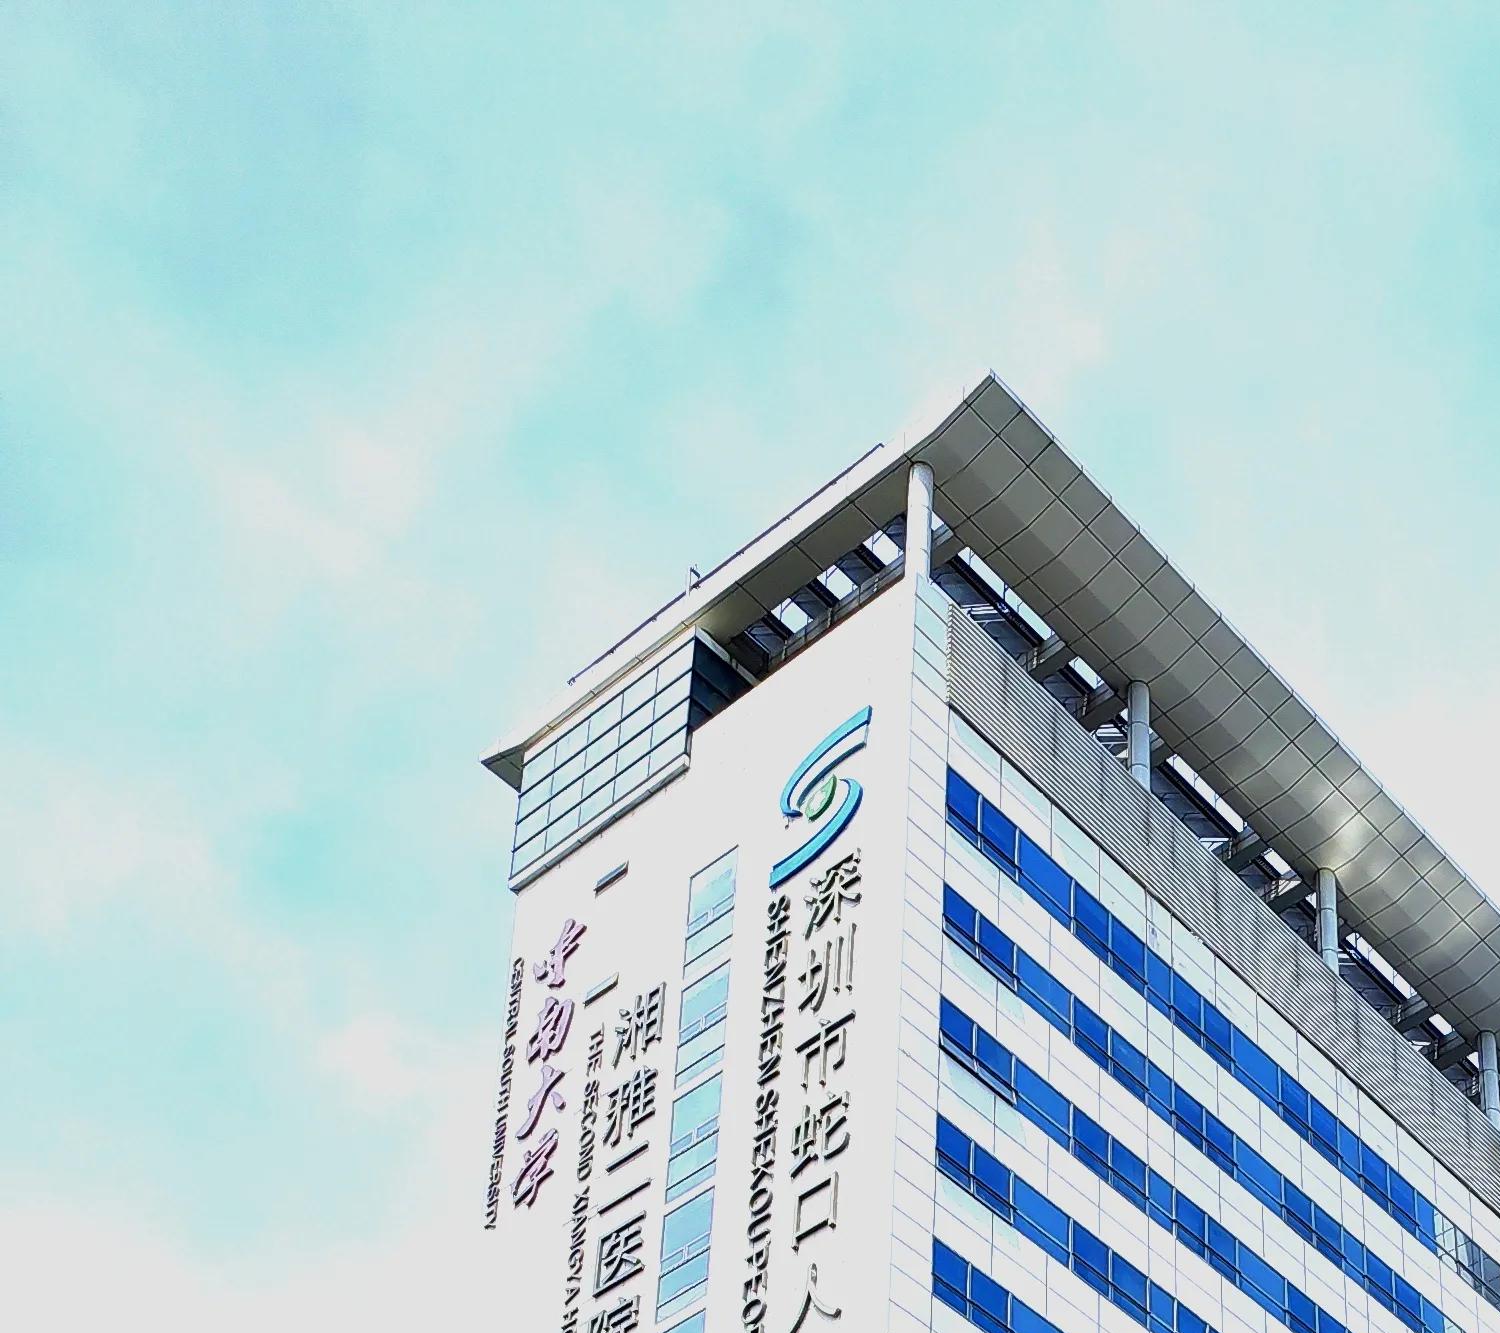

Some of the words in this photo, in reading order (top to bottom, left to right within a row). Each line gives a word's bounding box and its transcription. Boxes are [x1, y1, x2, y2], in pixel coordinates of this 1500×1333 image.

[505, 957, 525, 1045] CENTRAL
[585, 1022, 604, 1077] THE
[757, 894, 791, 1088] SHENZHEN
[497, 1045, 516, 1113] SOUTH
[511, 918, 587, 1209] 中南大学
[484, 1112, 509, 1230] UNIVERSITY
[577, 1079, 600, 1183] SECOND
[746, 1088, 779, 1244] SHEKOU
[564, 1186, 590, 1306] XIANGYA
